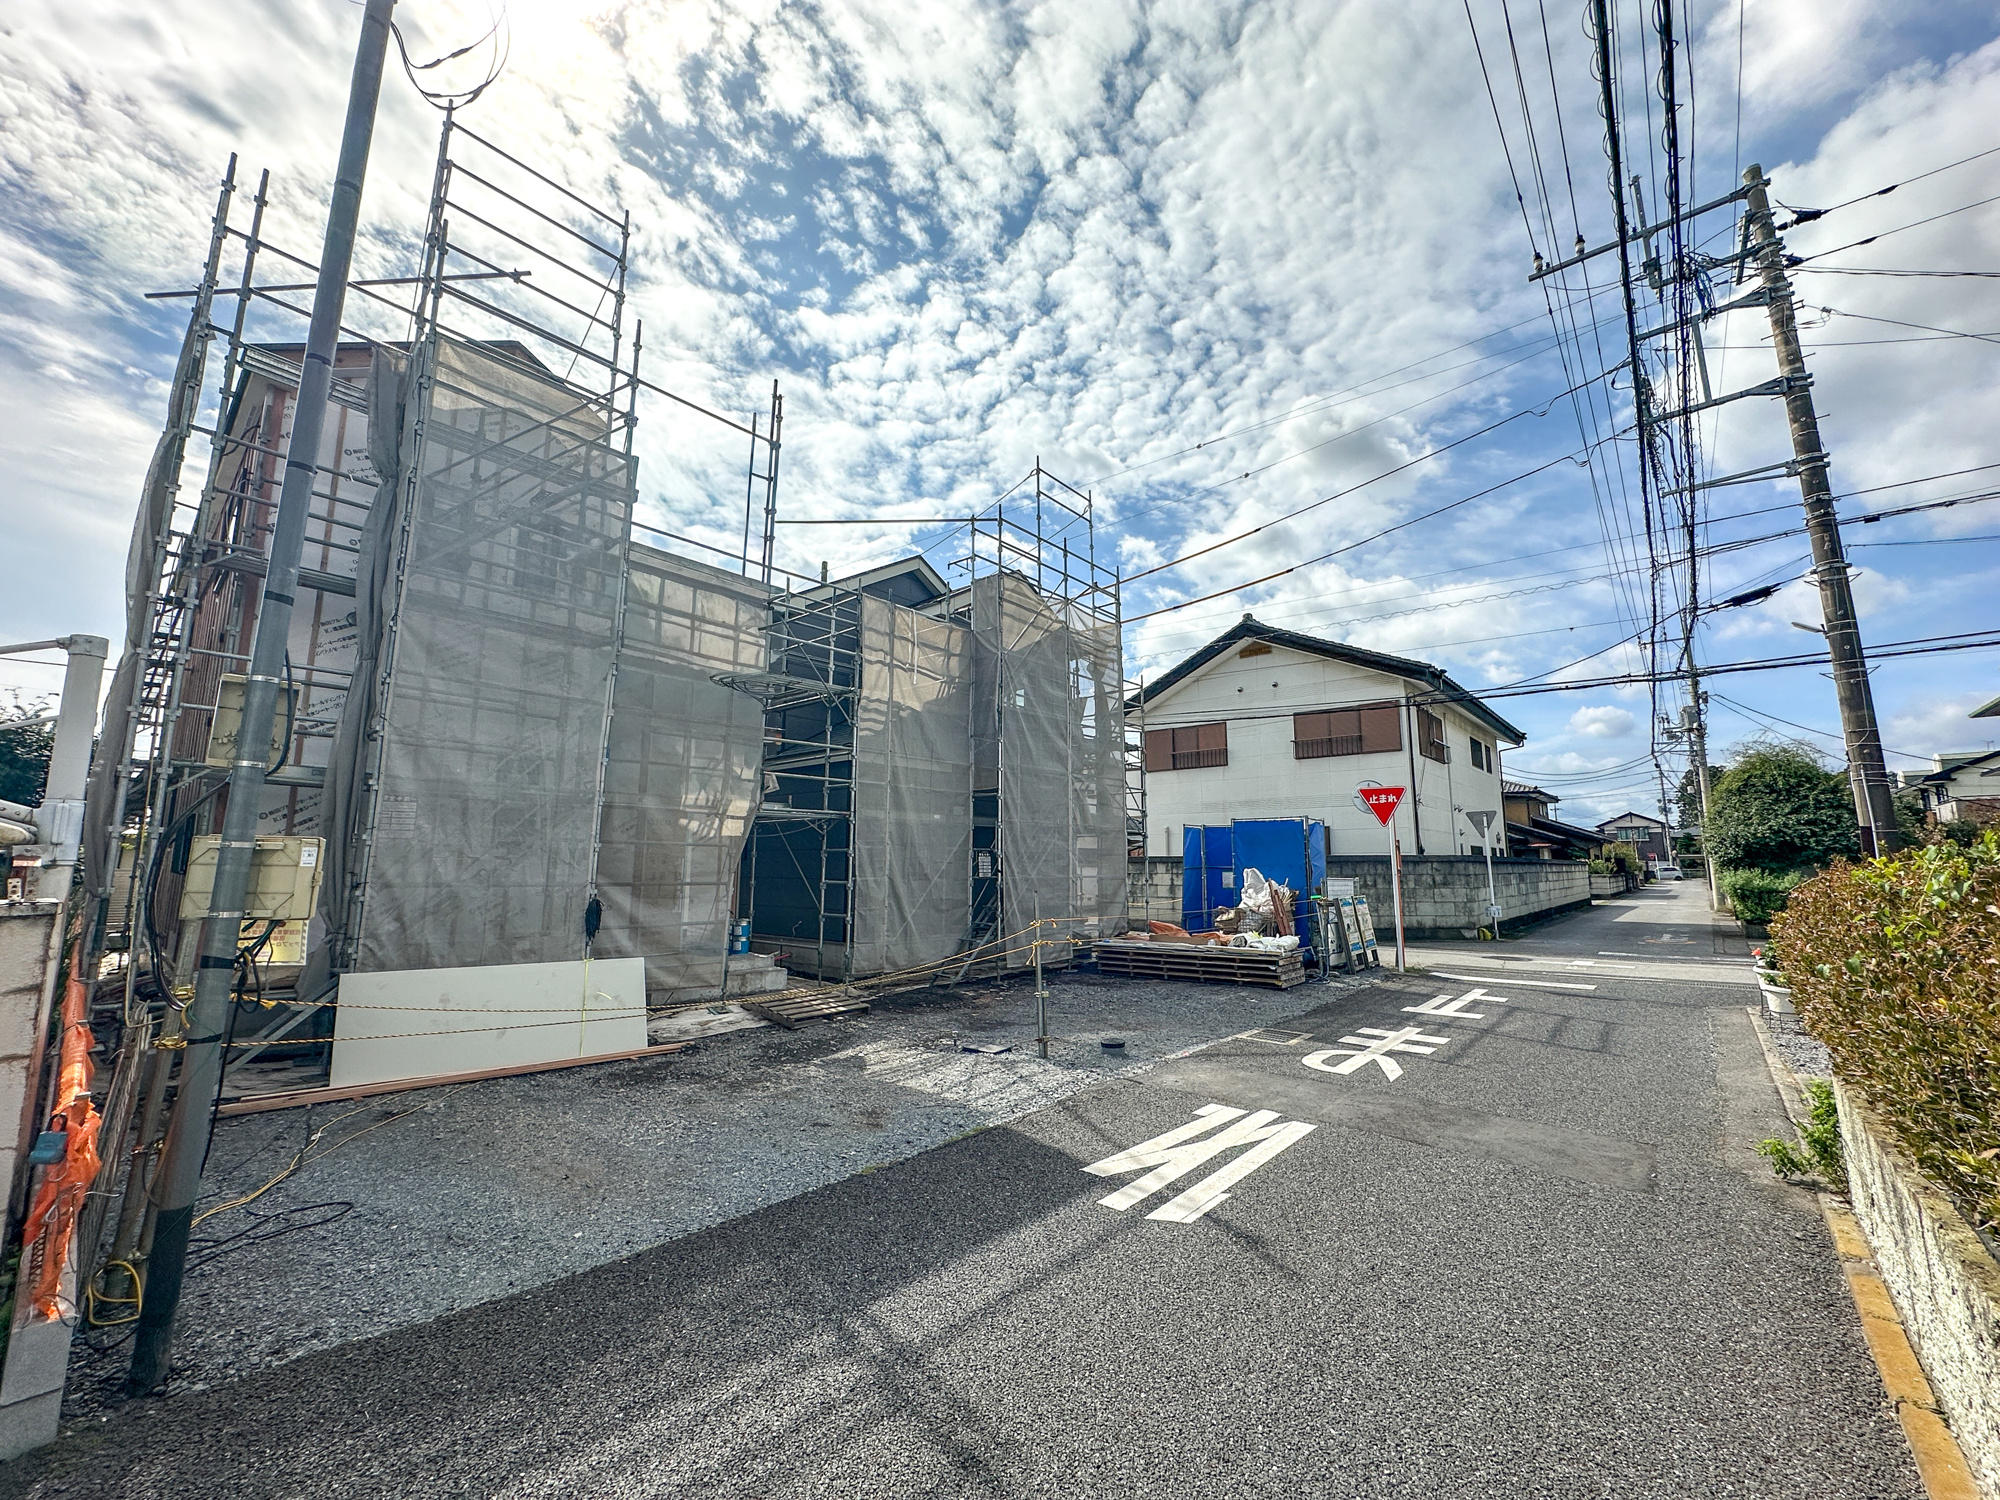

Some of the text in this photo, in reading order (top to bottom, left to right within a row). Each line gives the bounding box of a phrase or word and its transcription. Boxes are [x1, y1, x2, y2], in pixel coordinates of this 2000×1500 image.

[1369, 793, 1398, 804] 止まれ
[1081, 988, 1508, 1224] 止まれ
